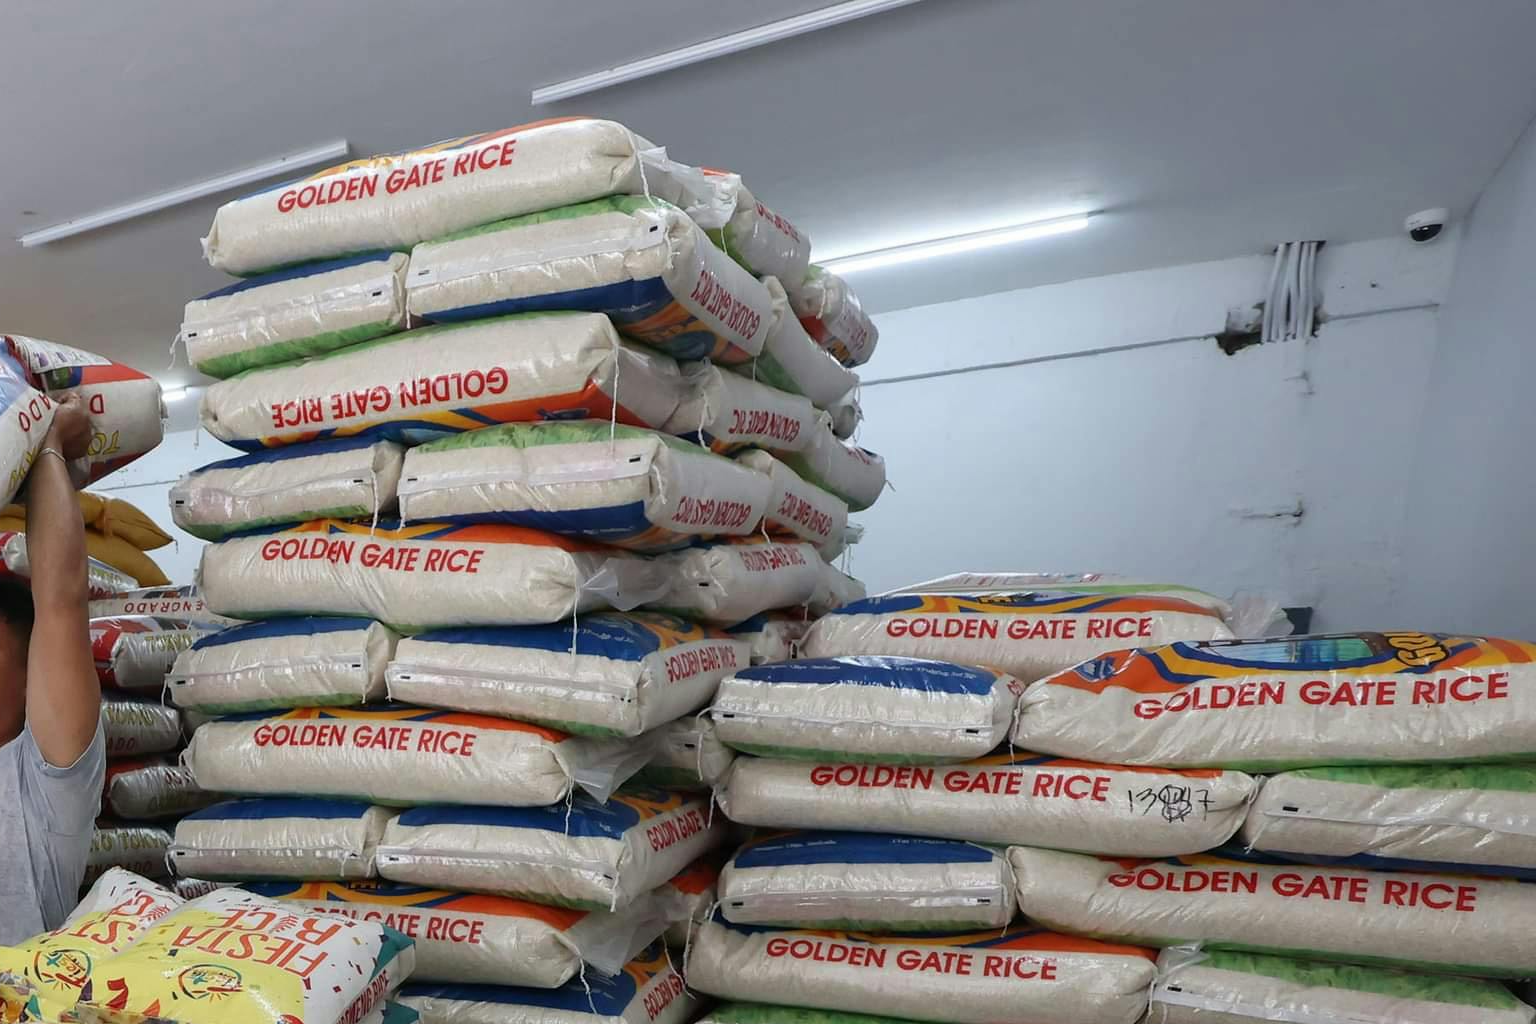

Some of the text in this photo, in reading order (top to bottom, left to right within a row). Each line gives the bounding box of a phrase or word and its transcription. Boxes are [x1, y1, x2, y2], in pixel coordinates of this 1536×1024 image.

[276, 139, 519, 214] GOLDEN GATE RICE
[271, 366, 509, 428] GOLDEN GATE RICE
[261, 537, 485, 575] GOLDEN GATE RICE
[885, 616, 1154, 641] GOLDEN GATE RICE
[1132, 671, 1511, 721] GOLDEN GATE RICE
[253, 723, 477, 758] GOLDEN GATE RICE
[810, 764, 1111, 802] GOLDEN GATE RICE
[1107, 867, 1478, 913] GOLDEN GATE RICE
[170, 926, 331, 979] FIESTA
[426, 915, 485, 945] RICE
[764, 936, 1058, 982] GOLDEN GATE RICE
